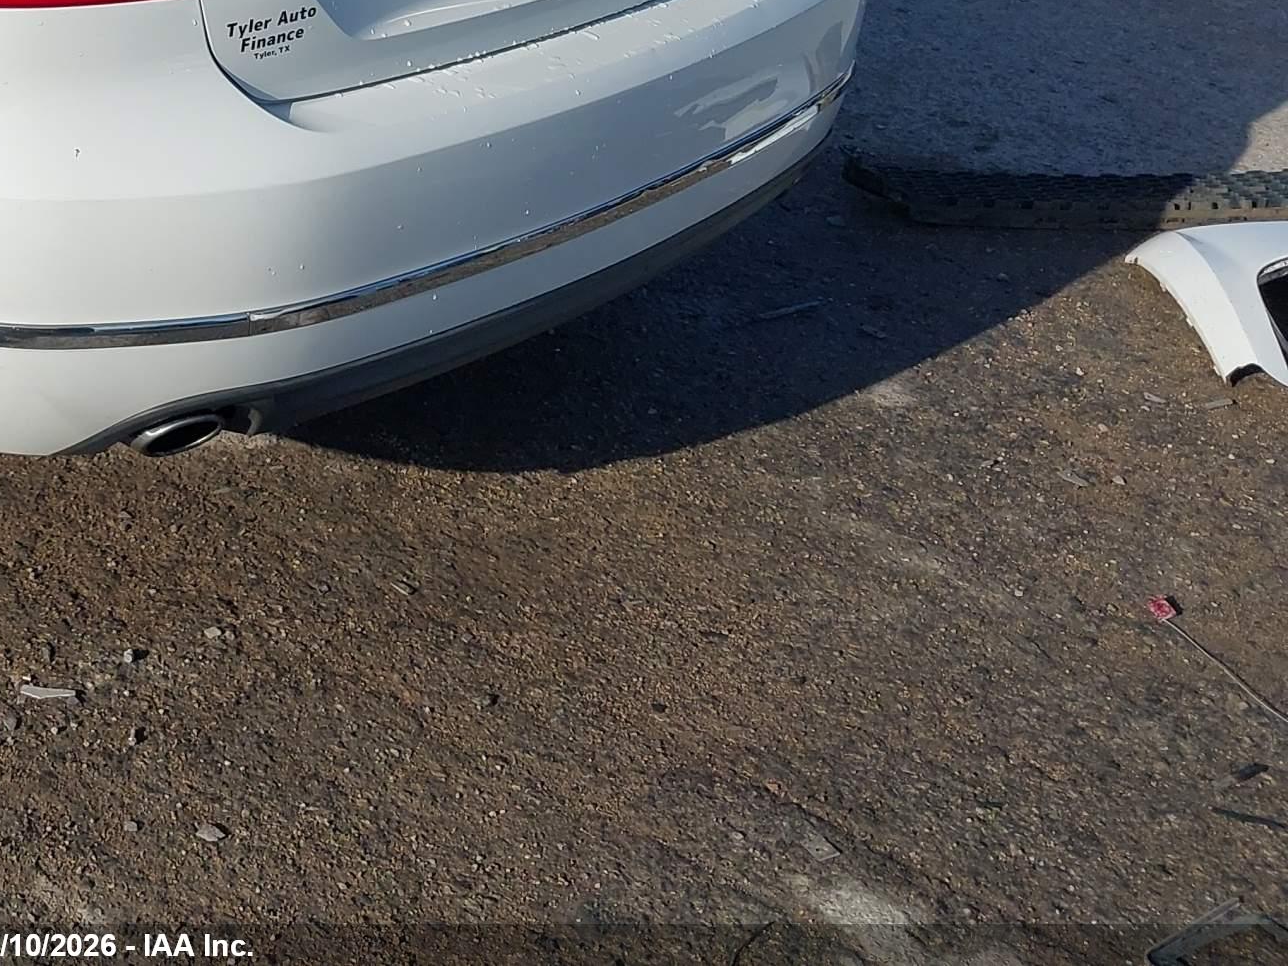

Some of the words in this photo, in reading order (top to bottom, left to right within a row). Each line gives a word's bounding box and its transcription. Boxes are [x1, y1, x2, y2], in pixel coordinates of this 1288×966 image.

[226, 18, 272, 39] Tyler
[277, 6, 317, 26] Auto
[240, 27, 305, 53] Finance
[253, 50, 278, 60] Tyler,
[278, 44, 291, 54] TX
